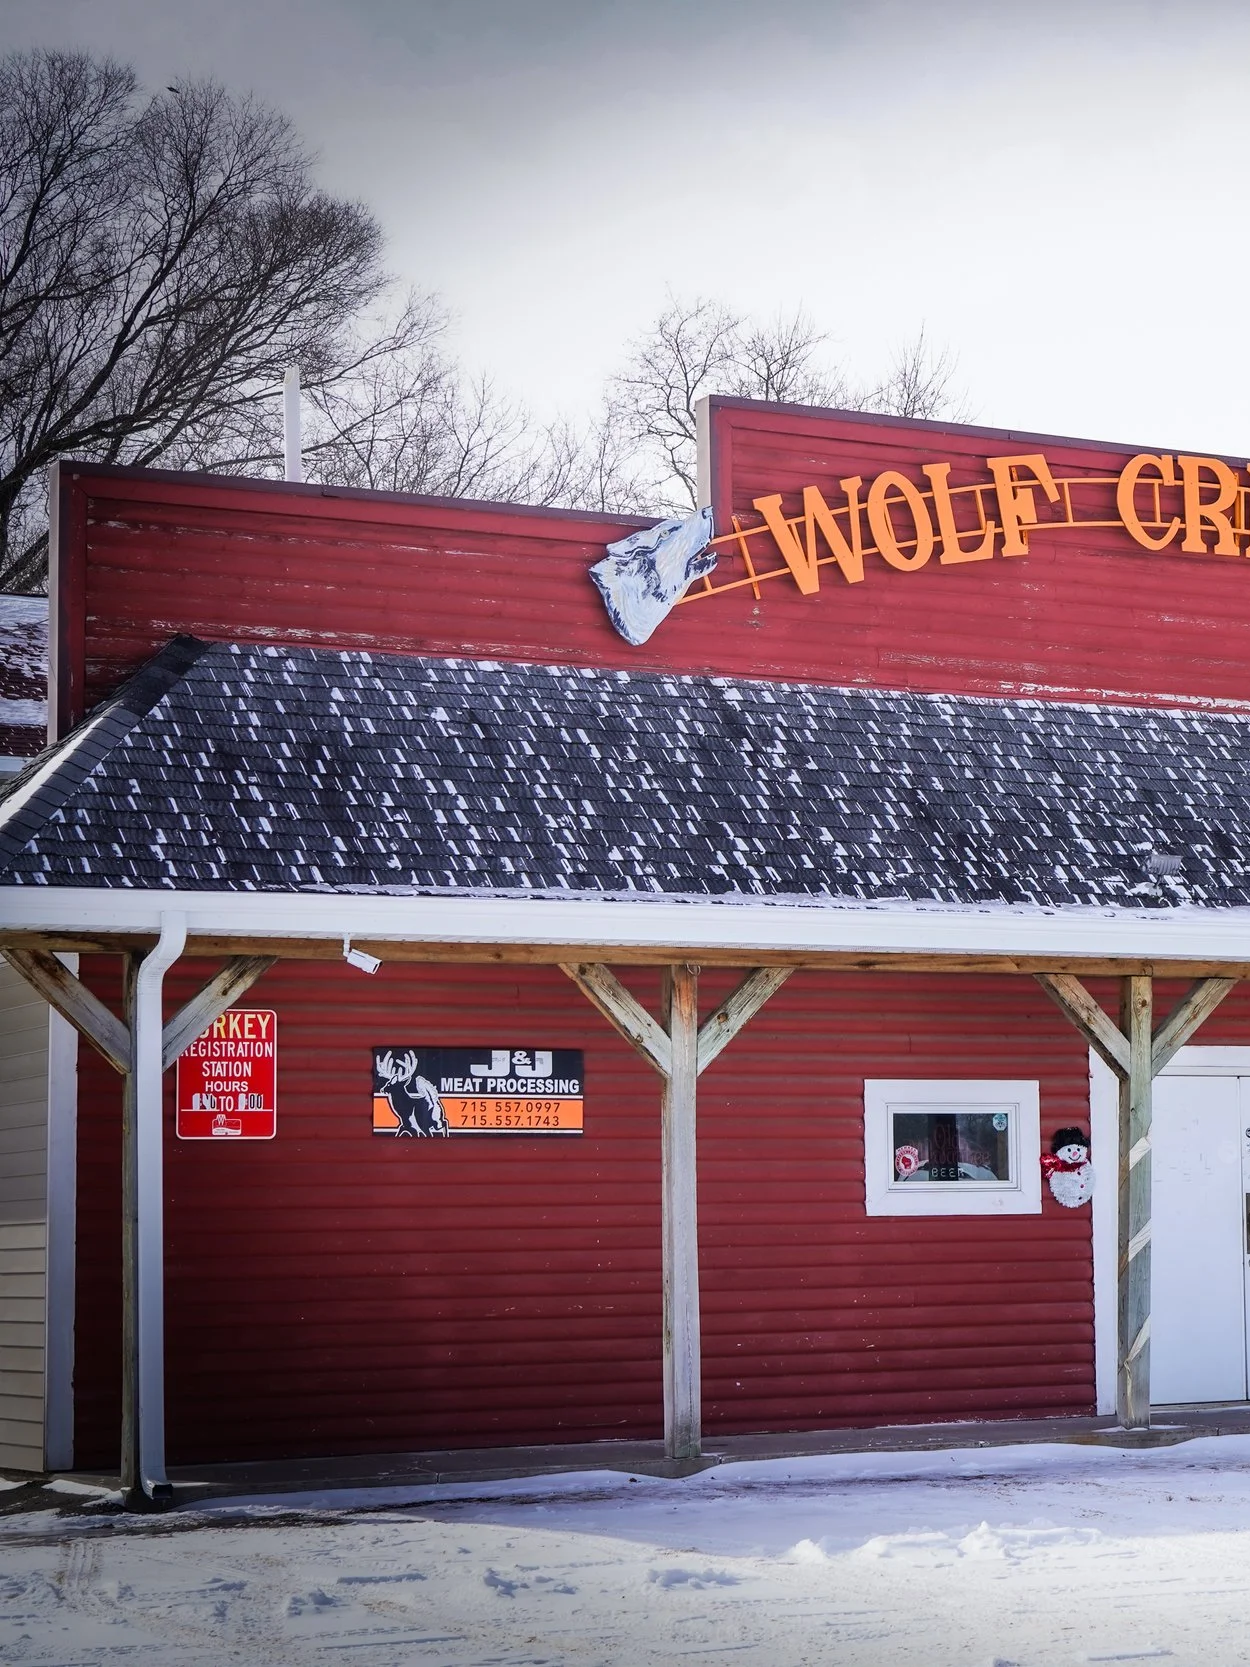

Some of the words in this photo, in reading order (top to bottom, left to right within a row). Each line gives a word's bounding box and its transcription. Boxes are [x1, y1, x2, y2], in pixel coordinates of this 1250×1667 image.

[753, 454, 1061, 595] WOLF
[200, 1014, 271, 1039] RKEY
[202, 1061, 252, 1077] STATION
[470, 1050, 553, 1078] J&J
[205, 1080, 249, 1092] HOURS
[441, 1077, 482, 1093] MEAT
[487, 1078, 580, 1094] PROCESSING
[219, 1095, 234, 1112] TO
[461, 1115, 560, 1126] 715.557.1743
